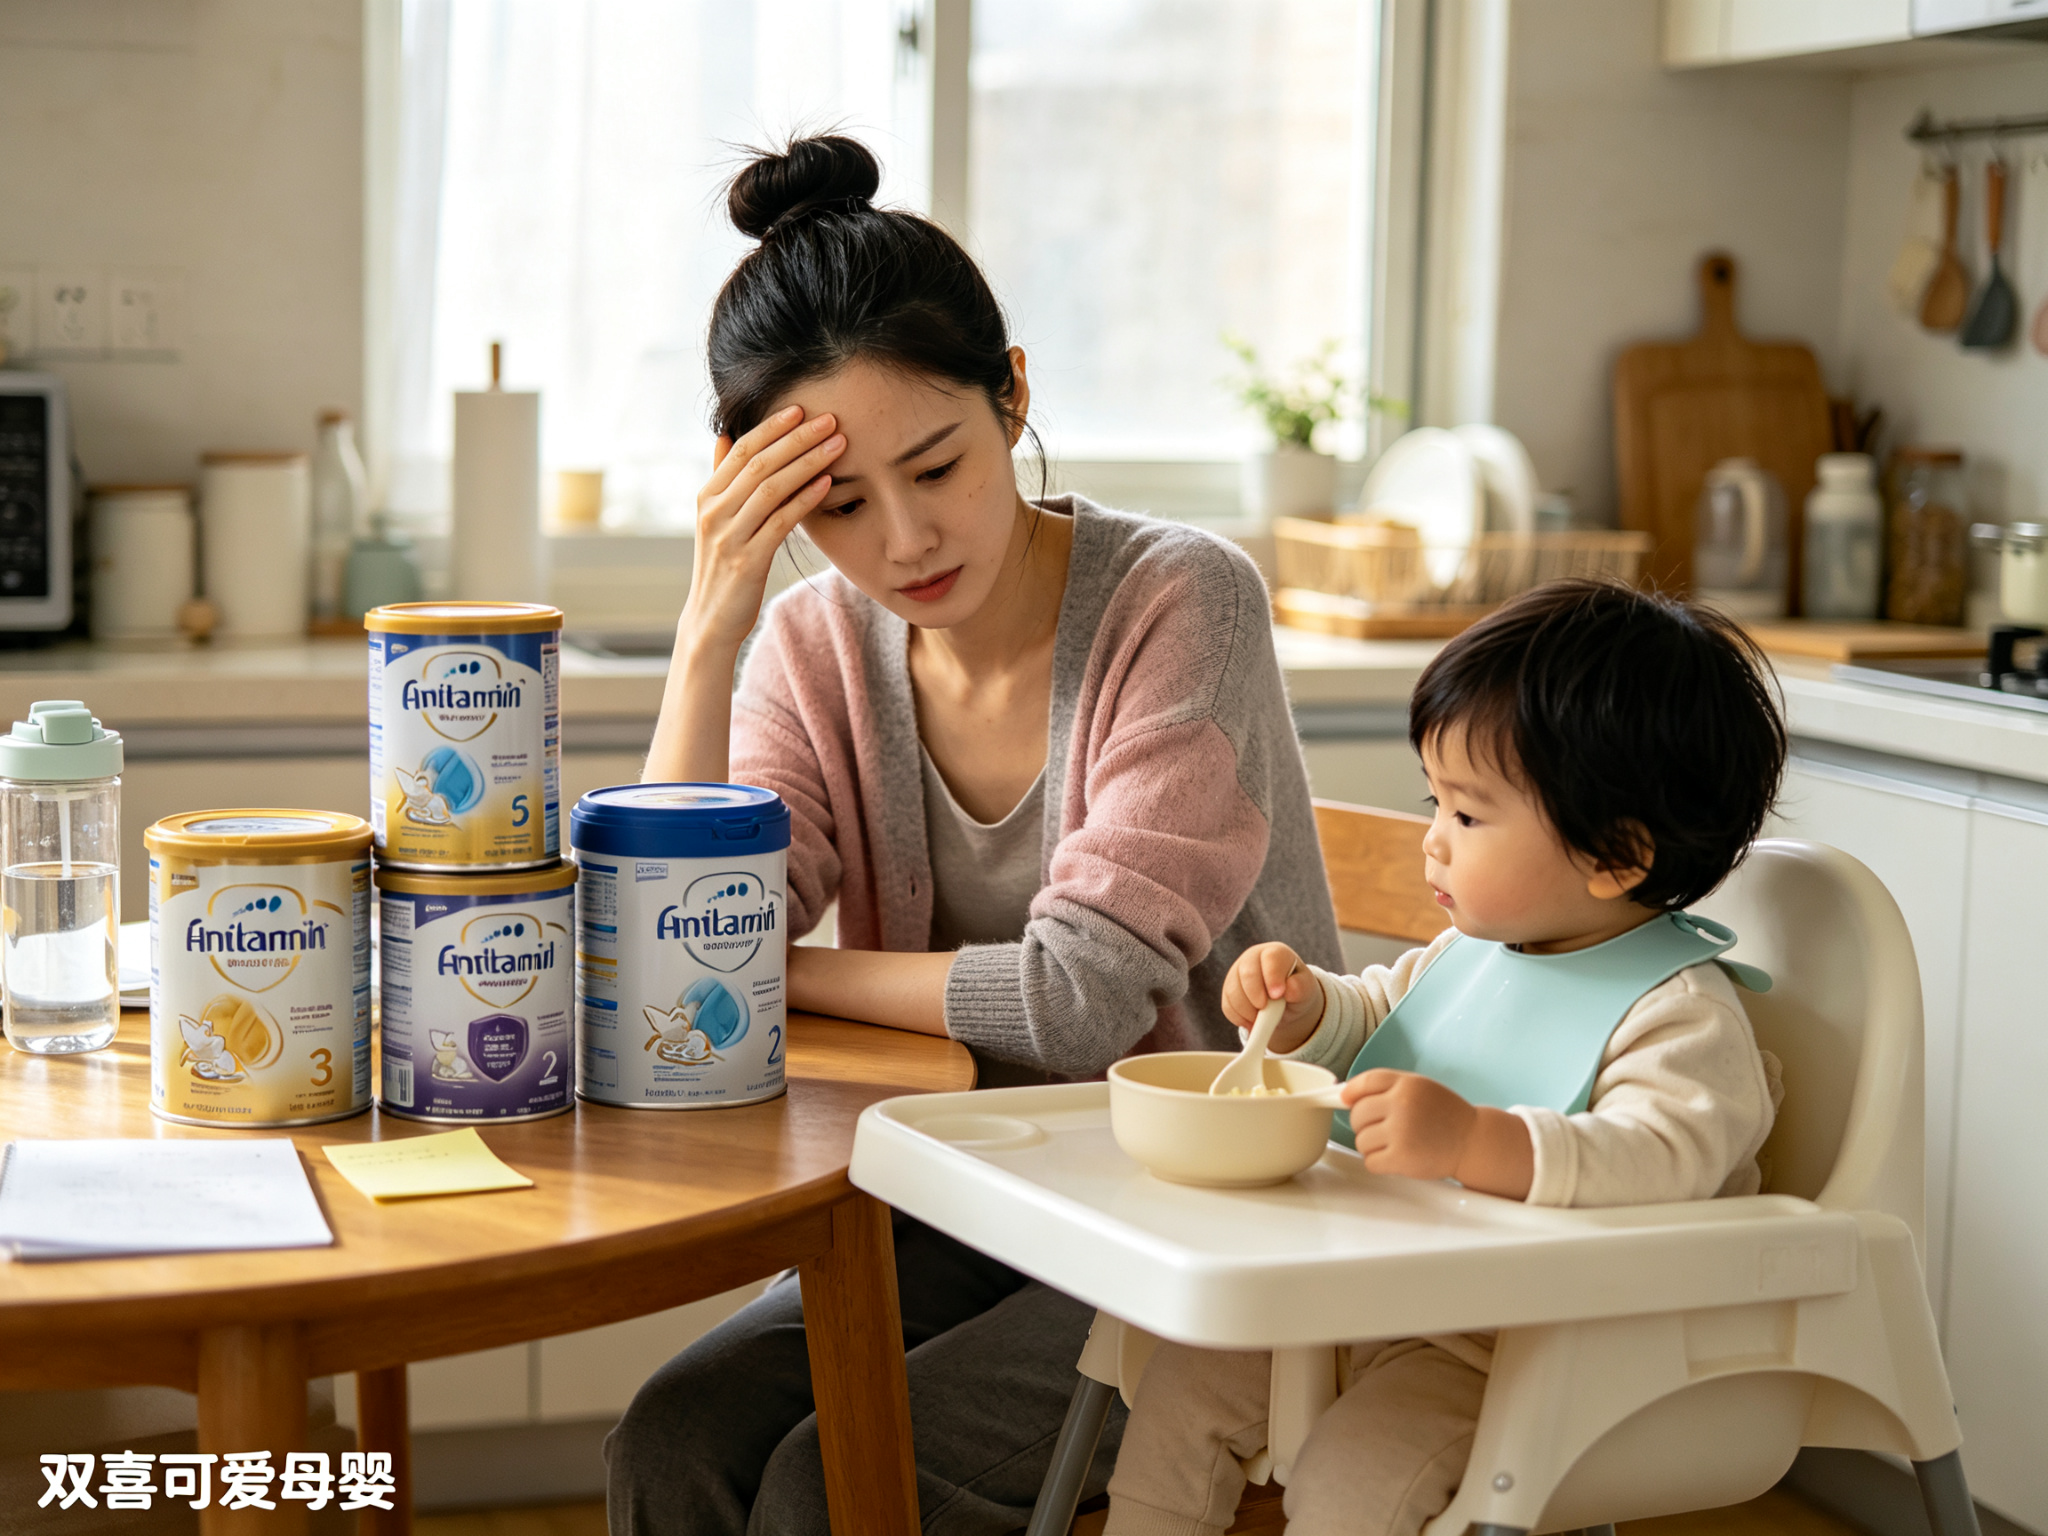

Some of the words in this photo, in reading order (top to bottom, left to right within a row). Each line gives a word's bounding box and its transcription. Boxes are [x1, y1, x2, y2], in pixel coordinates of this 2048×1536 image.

[512, 795, 530, 827] 5
[768, 1025, 782, 1065] 2
[309, 1048, 332, 1087] 3
[542, 1050, 558, 1079] 2
